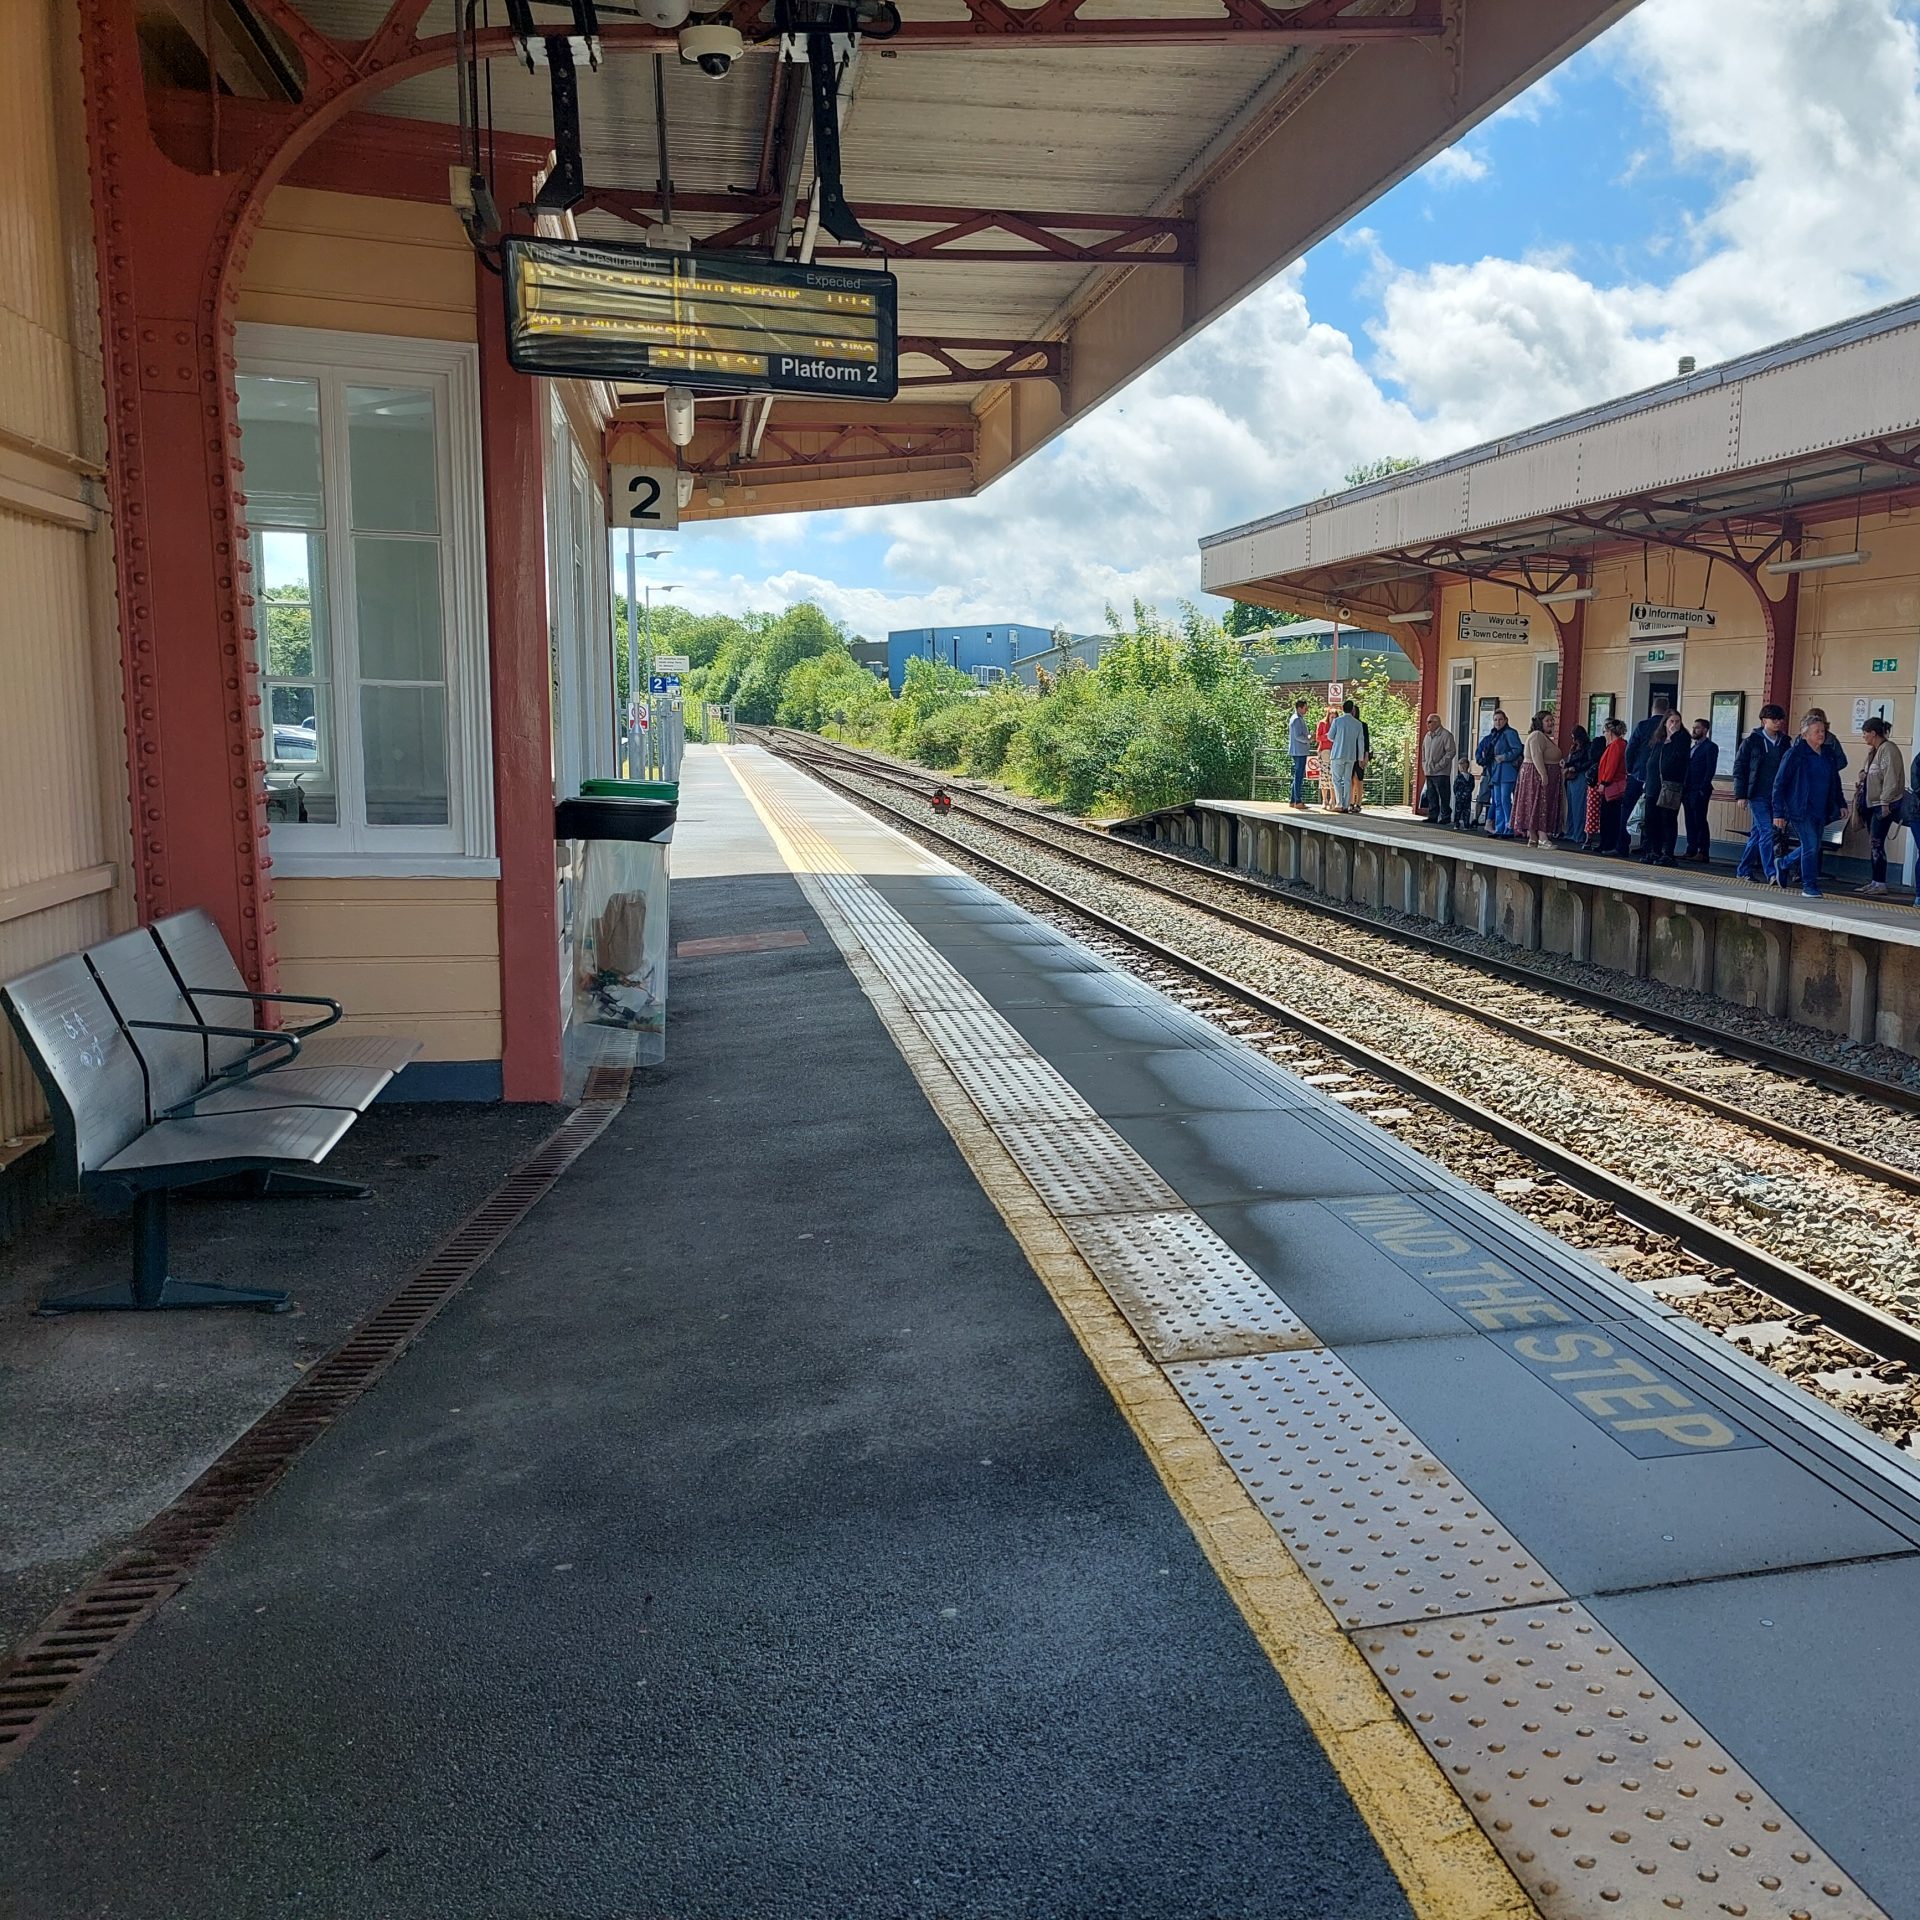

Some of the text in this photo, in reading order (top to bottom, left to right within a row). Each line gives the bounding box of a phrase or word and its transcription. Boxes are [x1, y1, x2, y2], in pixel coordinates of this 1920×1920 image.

[586, 252, 657, 270] Destination
[806, 273, 862, 289] Expected
[781, 357, 862, 382] Platform
[867, 365, 878, 383] 2
[628, 475, 661, 520] 2
[1488, 616, 1518, 626] Way out
[1648, 607, 1703, 623] Information
[1472, 629, 1517, 641] Town Centre
[653, 678, 663, 690] 2
[1328, 1196, 1736, 1447] MIND THE STEP
